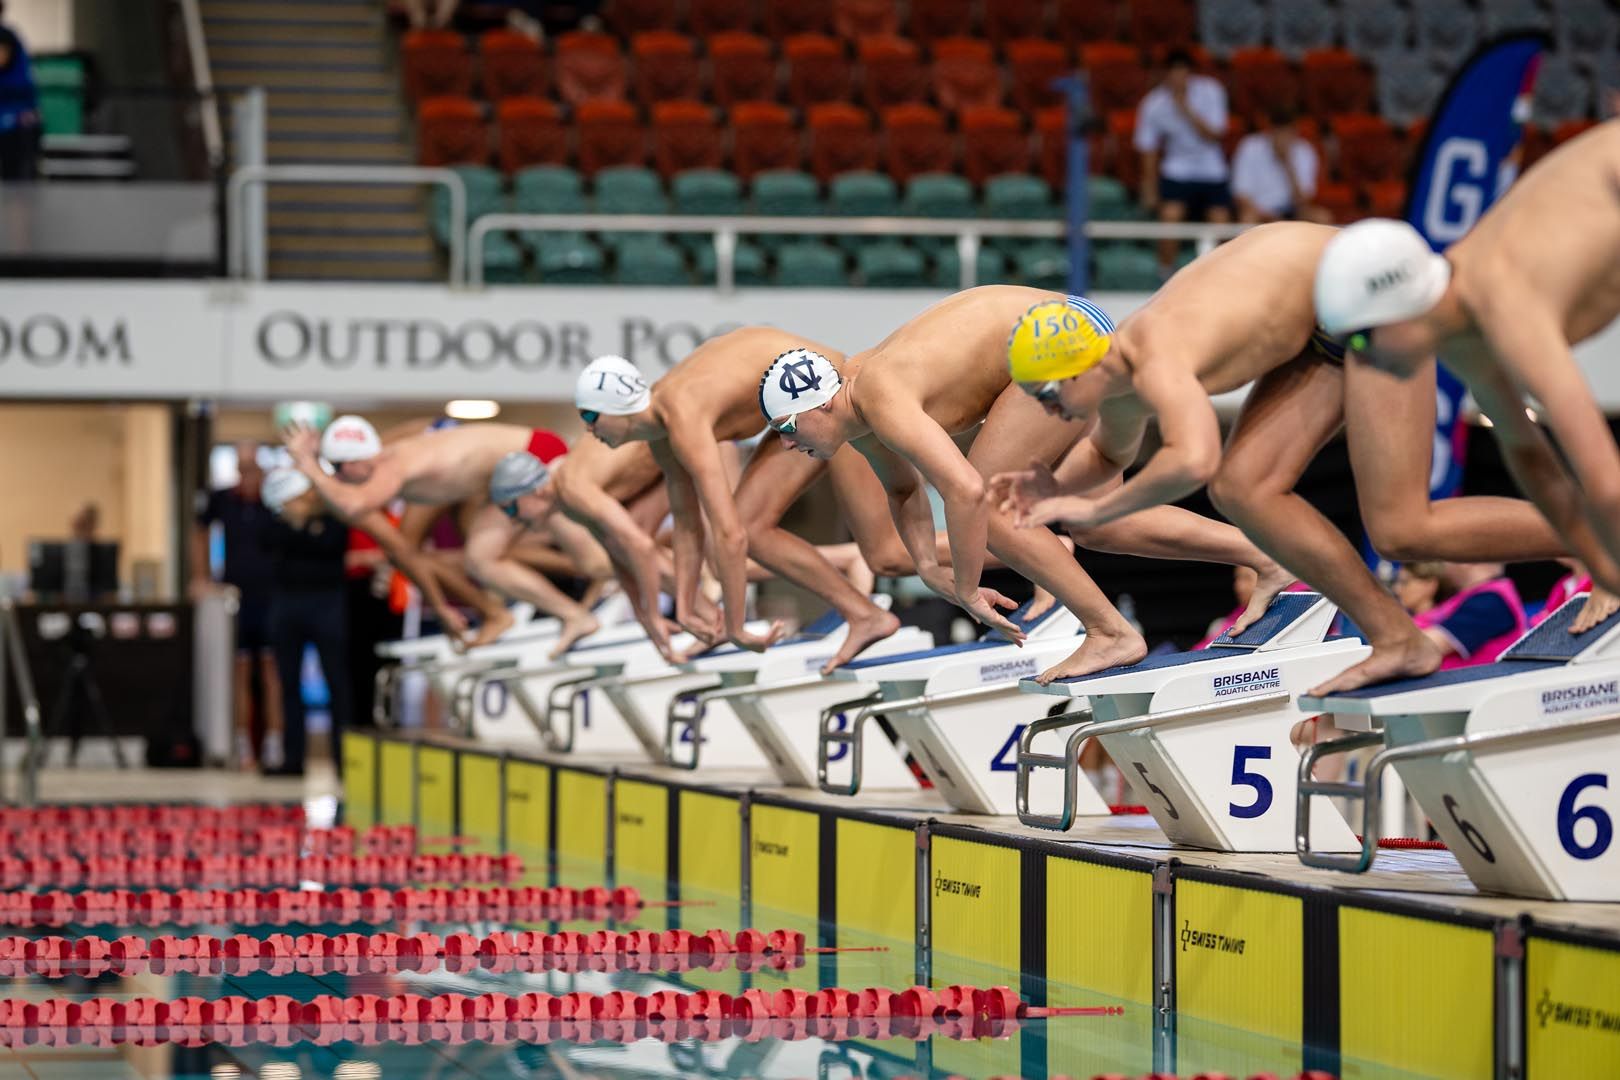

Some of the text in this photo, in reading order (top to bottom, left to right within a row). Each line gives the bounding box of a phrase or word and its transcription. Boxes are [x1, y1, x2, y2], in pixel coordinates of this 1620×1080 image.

[0, 312, 134, 368] OM
[255, 309, 592, 371] OUTDOOR
[1034, 312, 1078, 338] 150
[1213, 668, 1279, 688] BRISBANE
[1215, 680, 1280, 697] AQUATIC CENTRE
[1541, 680, 1618, 704] BRISBANE
[1543, 701, 1582, 715] AQUATIC
[990, 723, 1035, 772] 4
[1132, 761, 1179, 820] 5
[1229, 744, 1273, 819] 5
[1442, 793, 1496, 864] 6
[1556, 772, 1613, 861] 6
[1191, 930, 1246, 956] SWISS TIMING
